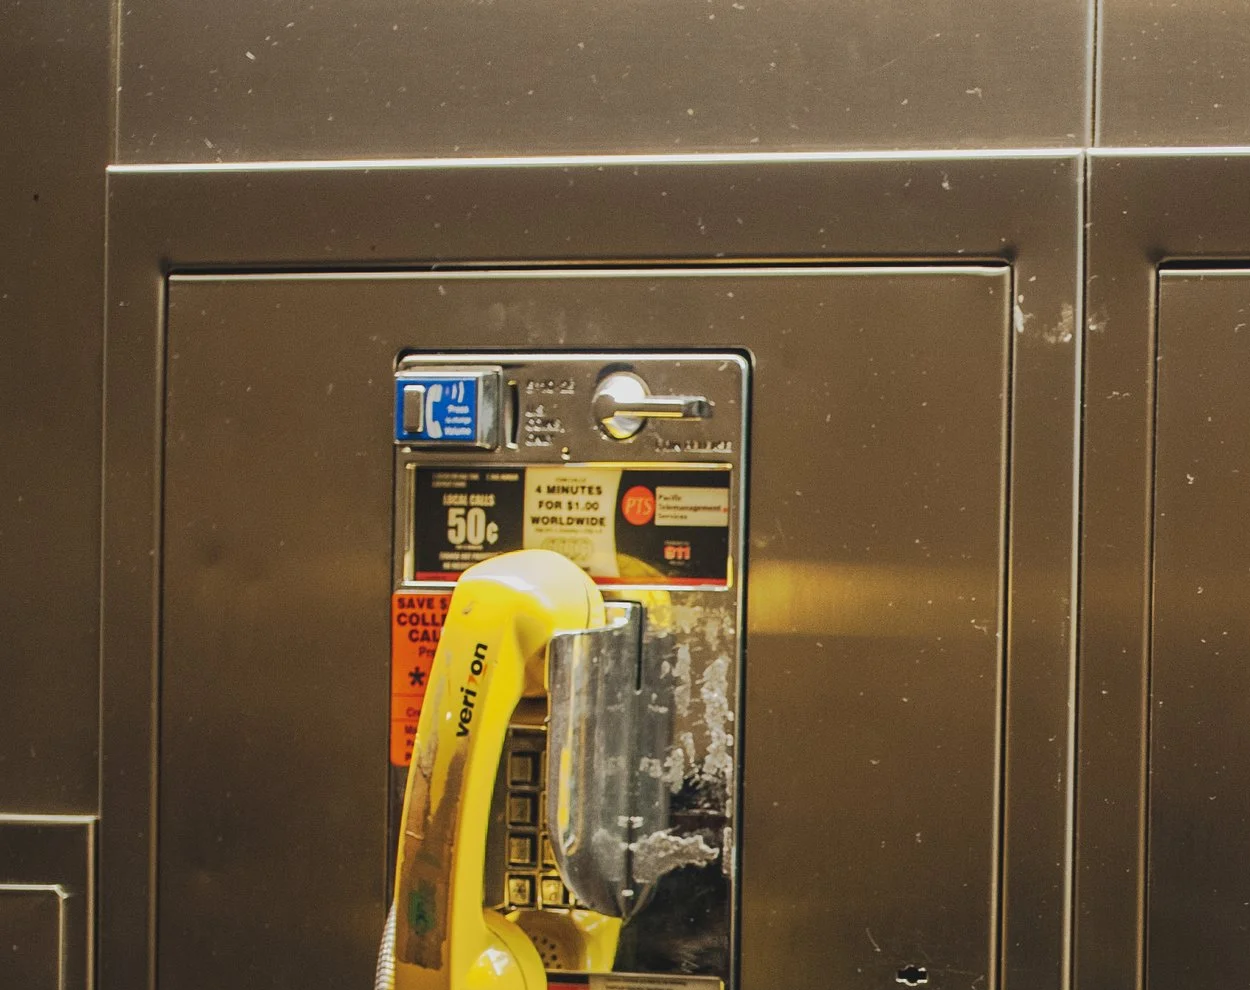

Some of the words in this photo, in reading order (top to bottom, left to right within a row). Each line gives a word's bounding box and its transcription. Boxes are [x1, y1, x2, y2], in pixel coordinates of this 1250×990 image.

[535, 485, 542, 493] 4
[547, 485, 602, 495] MINUTES
[538, 501, 562, 510] FOR
[567, 501, 600, 511] $1.00
[625, 496, 652, 516] PTS
[530, 516, 606, 527] WORLDWIDE
[397, 597, 434, 609] SAVE
